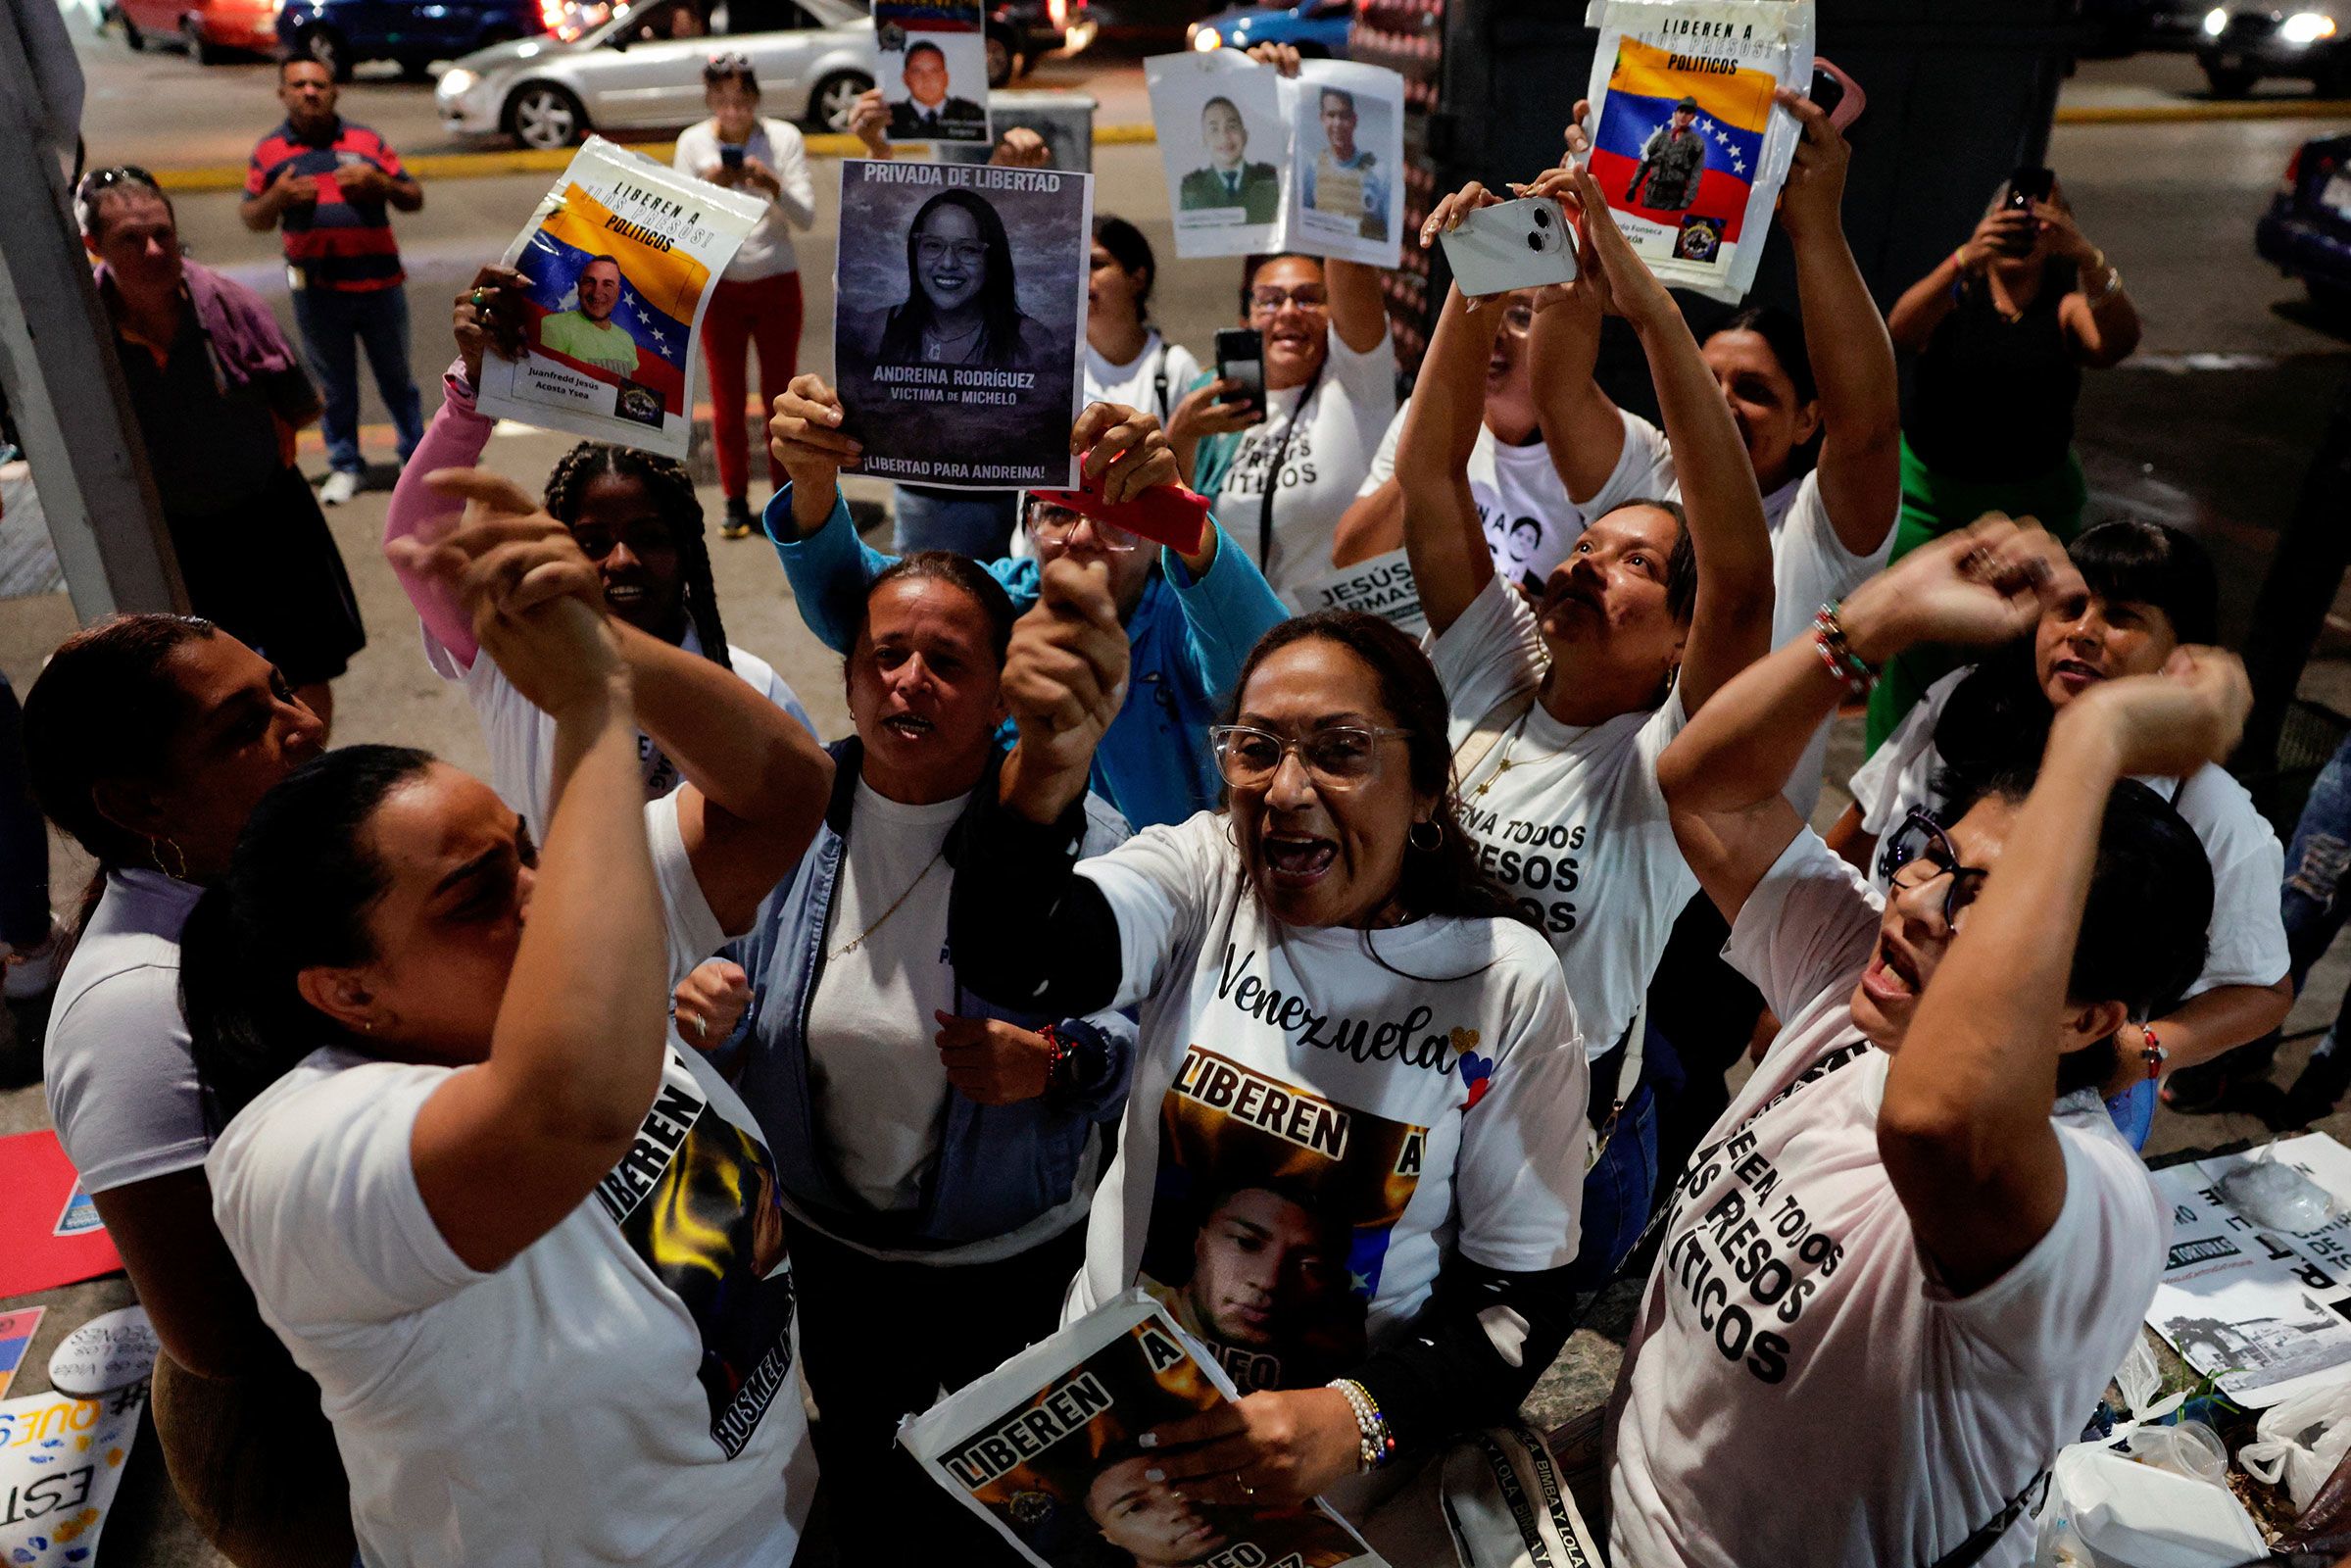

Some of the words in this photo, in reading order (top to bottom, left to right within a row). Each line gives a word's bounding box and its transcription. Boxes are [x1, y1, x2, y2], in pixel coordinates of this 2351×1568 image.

[1663, 19, 1734, 38] LIBEREN
[1743, 24, 1752, 39] A
[863, 163, 943, 186] PRIVADA
[948, 168, 971, 187] DE
[975, 169, 1060, 193] LIBERTAD
[613, 181, 683, 218] LIBEREN
[688, 212, 701, 225] A
[605, 214, 674, 253] POLITICOS
[528, 367, 574, 383] Juanfredd
[575, 378, 599, 391] Jesús
[535, 381, 566, 394] Acosta
[873, 366, 948, 384] ANDREINA
[954, 368, 1035, 388] RODRÍGUEZ
[891, 387, 944, 402] VICTIMA
[947, 391, 959, 402] DE
[961, 390, 1017, 405] MICHELO
[864, 456, 930, 474] ¡LIBERTAD
[934, 462, 969, 478] PARA
[972, 464, 1046, 479] ANDREINA!
[1320, 562, 1411, 607] JESÚS
[1347, 580, 1416, 611] RMAS
[1502, 820, 1587, 851] TODOS
[1218, 942, 1457, 1075] Venezuela
[1171, 1052, 1350, 1160] LIBEREN
[1396, 1132, 1424, 1176] A
[2307, 1237, 2344, 1255] DE
[711, 1348, 785, 1457] ROSMEL
[946, 1371, 1114, 1490] LIBEREN
[1138, 1328, 1186, 1373] A
[1536, 1459, 1560, 1509] BIMBA
[1552, 1510, 1567, 1522] Y
[1558, 1526, 1586, 1568] LOLA
